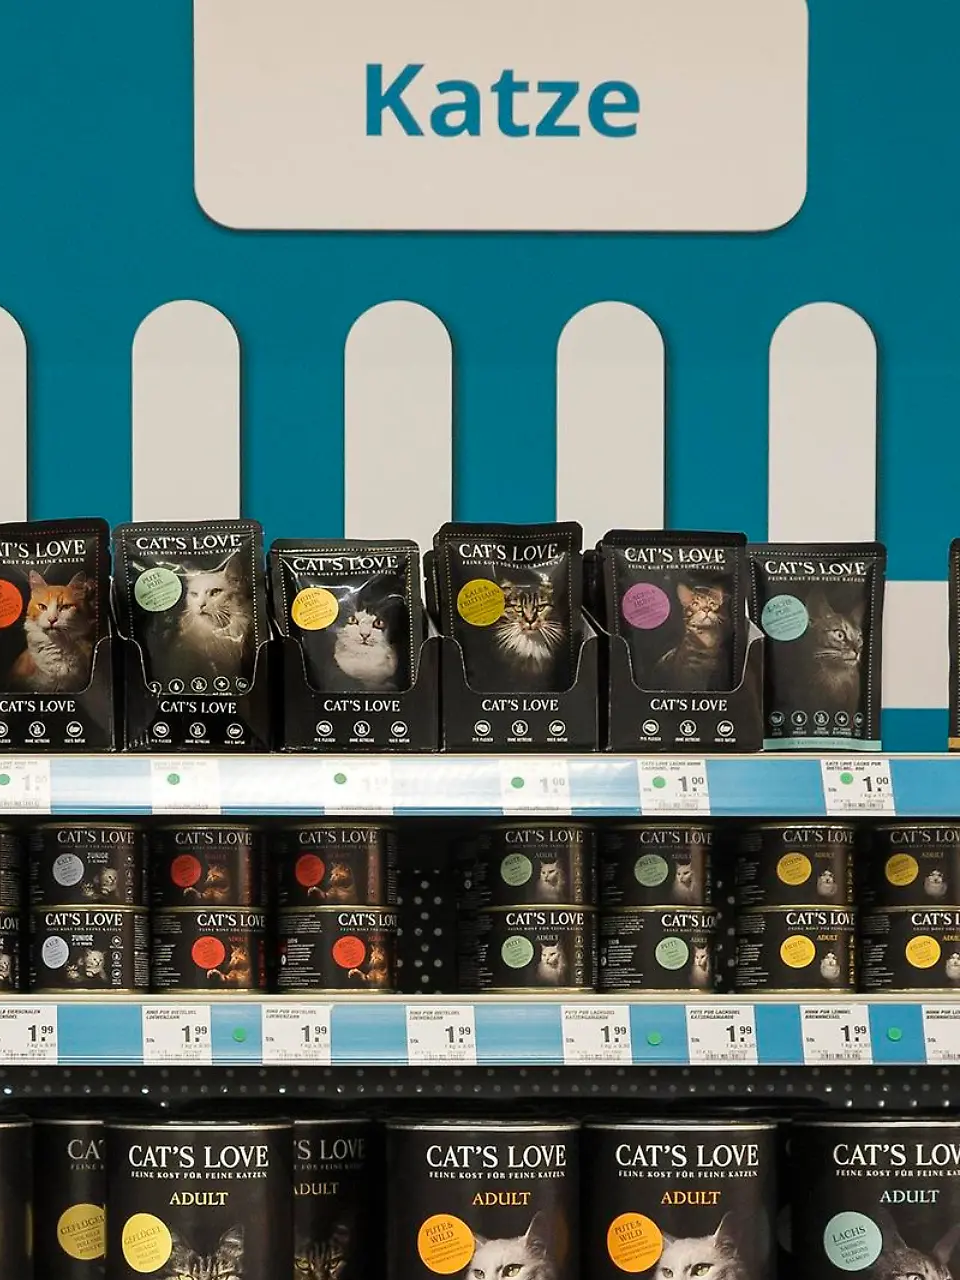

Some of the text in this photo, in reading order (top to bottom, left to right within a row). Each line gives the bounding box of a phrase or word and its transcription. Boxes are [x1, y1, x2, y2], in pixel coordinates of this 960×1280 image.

[366, 63, 640, 138] Katze
[36, 540, 86, 557] LOVE
[136, 534, 242, 550] CAT'S LOVE
[459, 543, 559, 561] CAT'S LOVE
[624, 548, 725, 564] CAT'S LOVE
[765, 561, 866, 576] CAT'S LOVE
[0, 700, 75, 712] CAT'S LOVE
[324, 700, 400, 712] CAT'S LOVE
[650, 700, 727, 712] CAT'S LOVE
[45, 913, 122, 926] CAT'S LOVE
[506, 912, 584, 927] CAT'S LOVE
[129, 1145, 269, 1168] CAT'S LOVE
[427, 1145, 566, 1168] CAT'S LOVE
[616, 1144, 759, 1167] CAT'S LOVE
[833, 1144, 960, 1166] CAT'S LOV
[169, 1192, 228, 1206] ADULT
[472, 1192, 530, 1205] ADULT
[661, 1191, 720, 1205] ADULT
[880, 1190, 940, 1203] ADULT
[430, 1230, 454, 1243] WILD
[832, 1226, 866, 1242] LACHS
